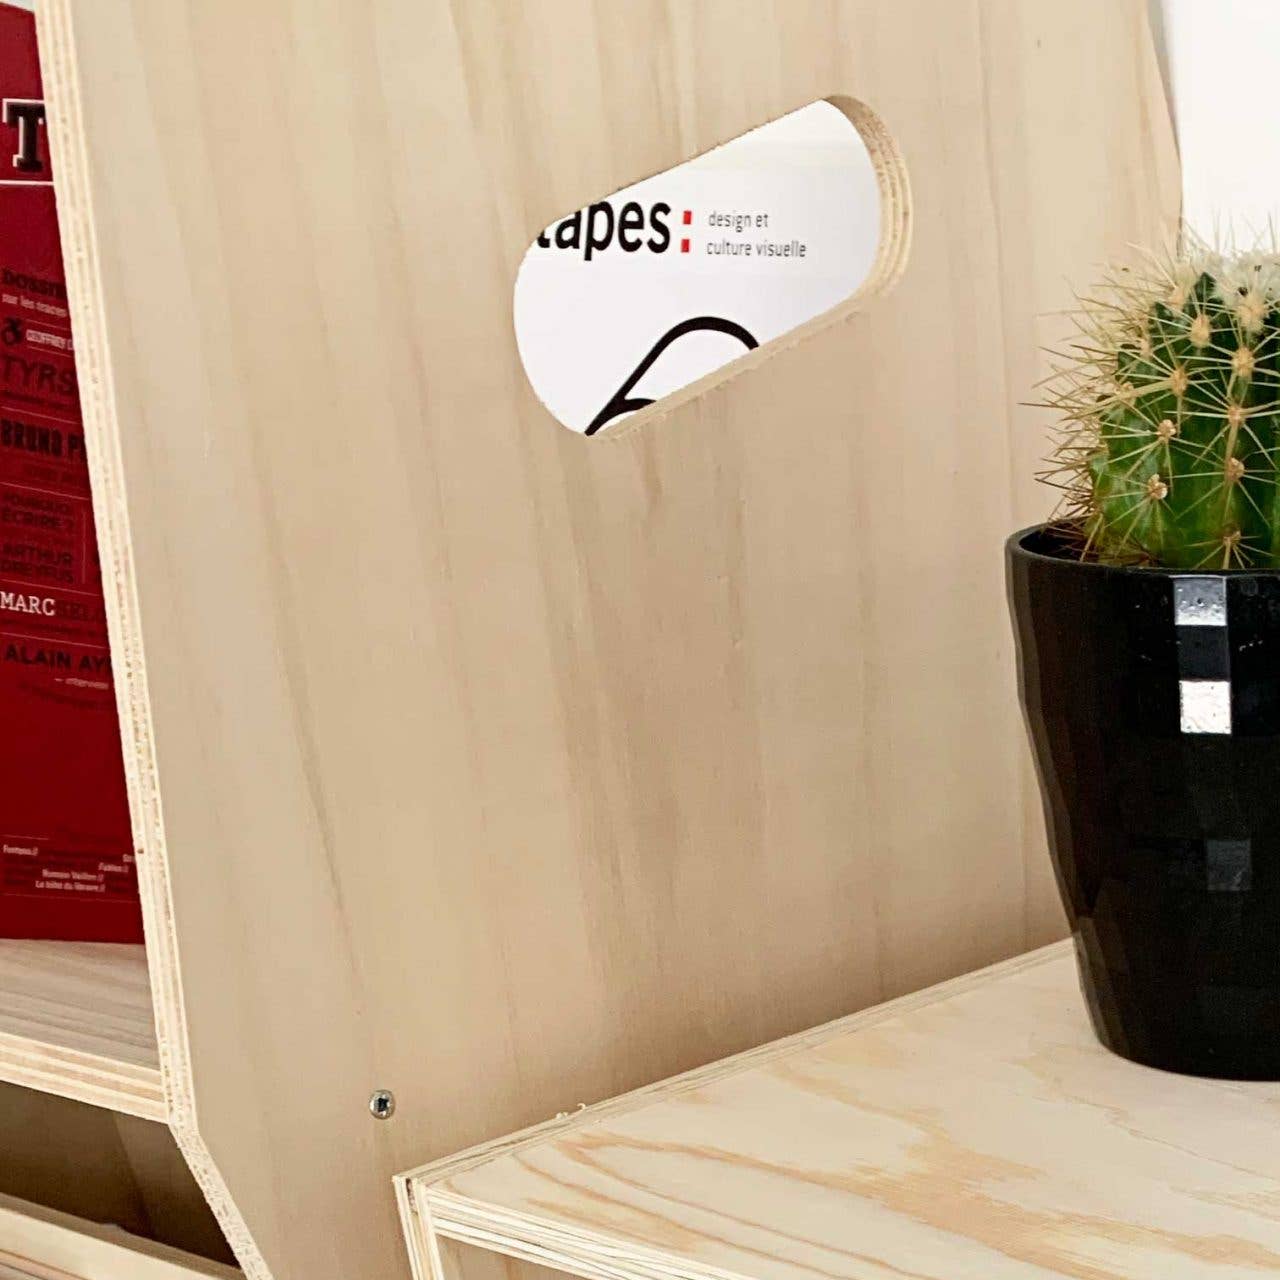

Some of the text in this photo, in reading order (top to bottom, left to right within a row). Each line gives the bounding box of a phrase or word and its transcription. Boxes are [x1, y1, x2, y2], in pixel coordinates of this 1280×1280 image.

[708, 211, 769, 232] design et
[706, 239, 807, 258] culture visuelle
[0, 591, 56, 616] MARC
[5, 644, 72, 669] ALAIN
